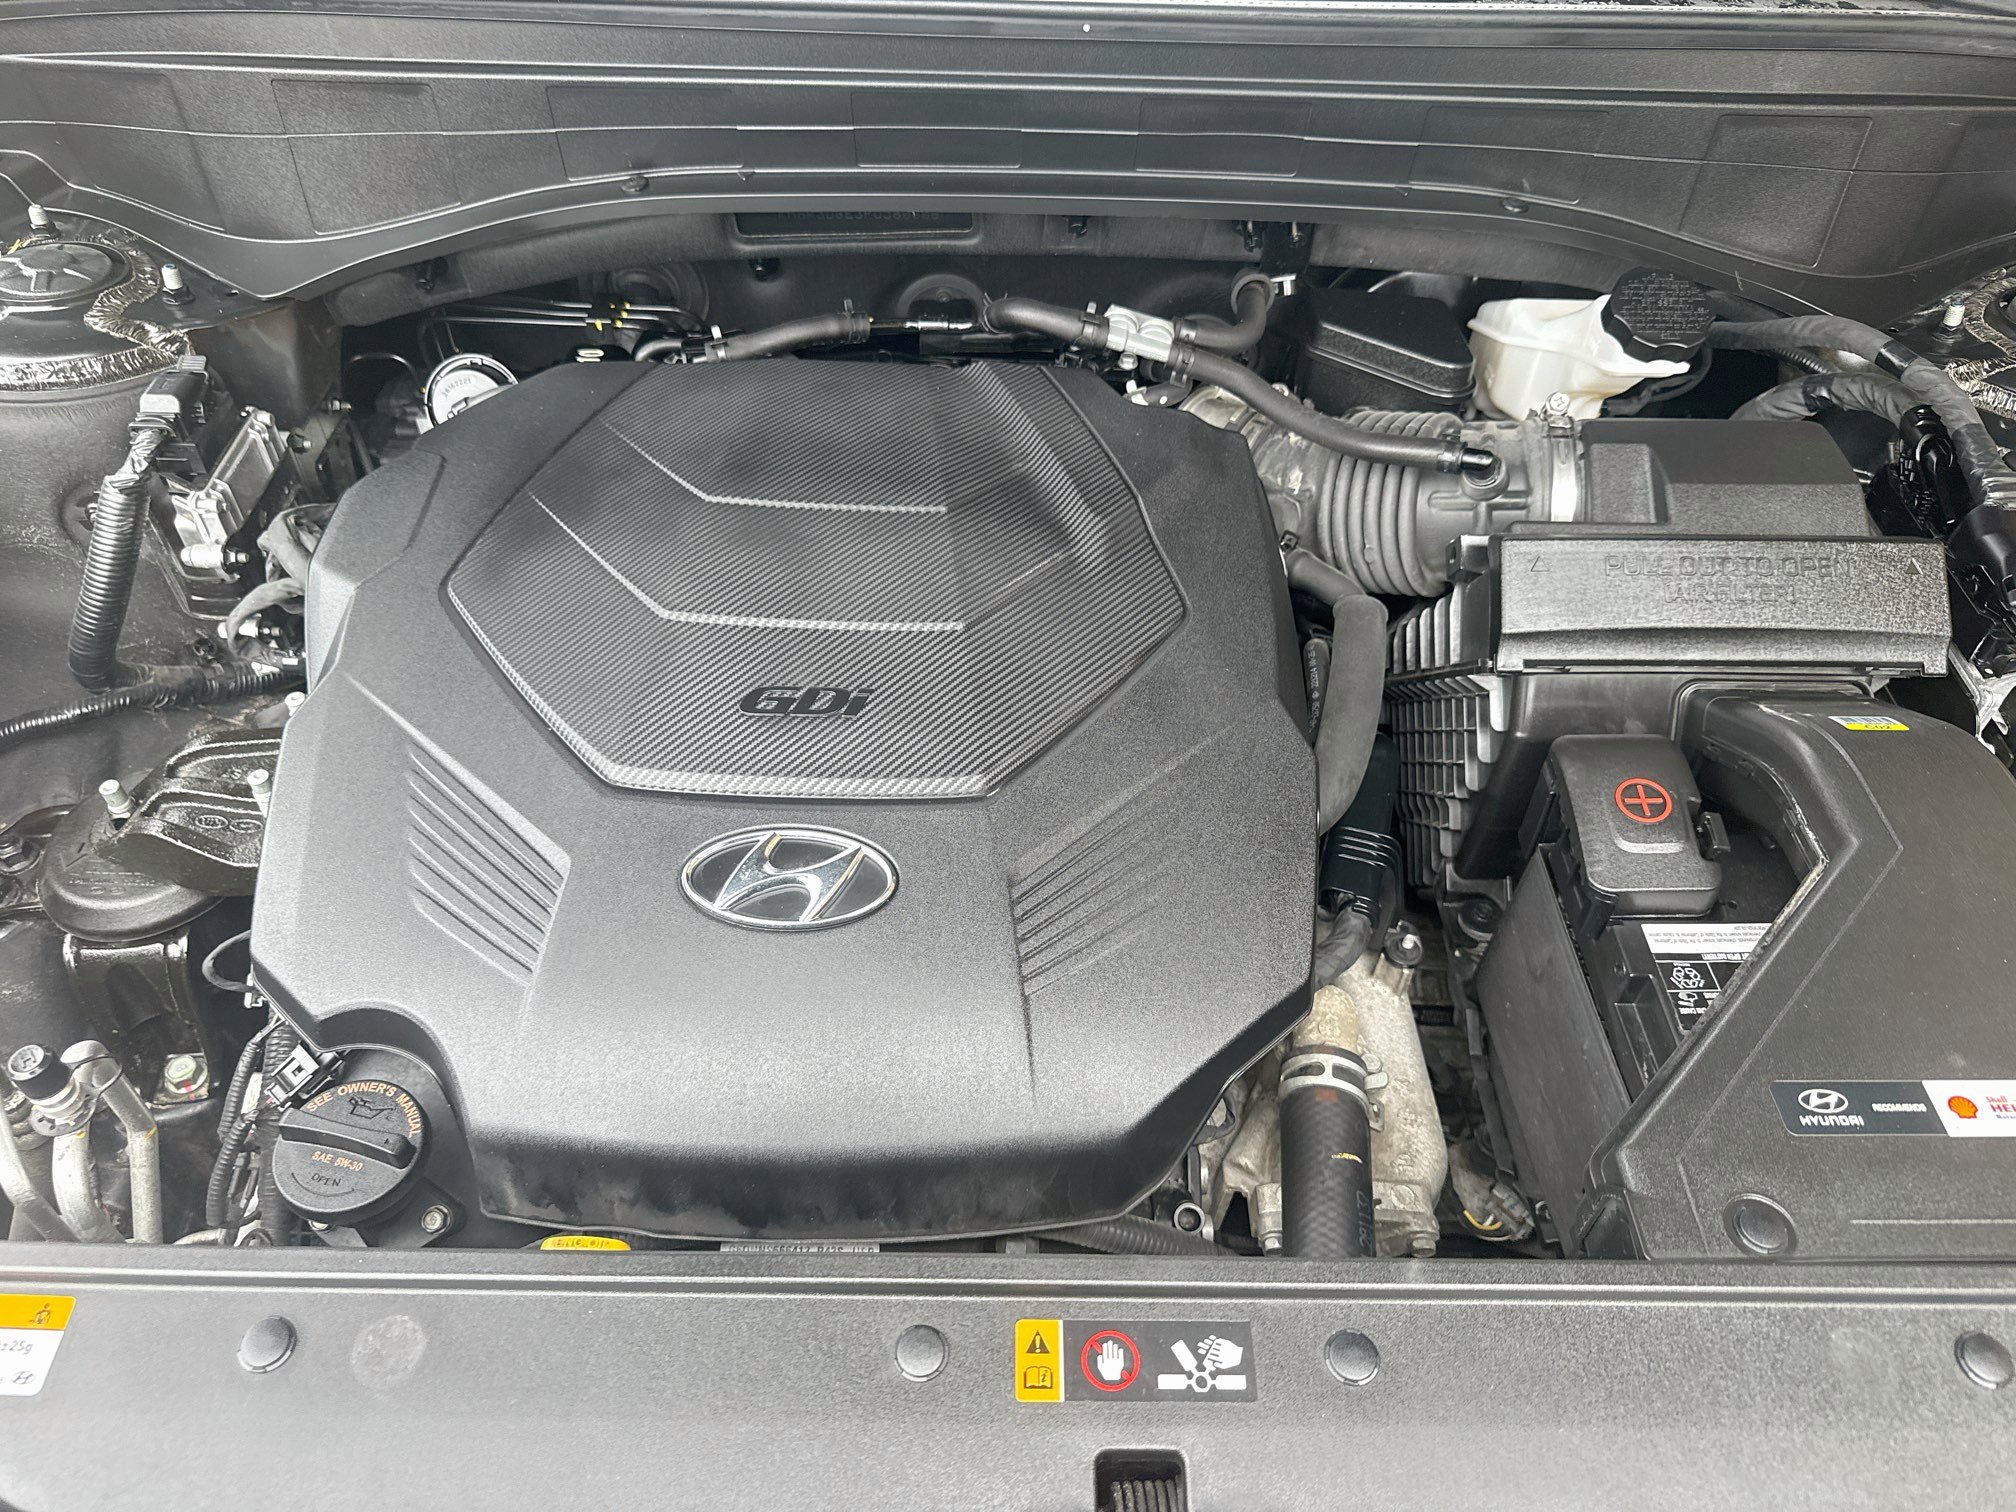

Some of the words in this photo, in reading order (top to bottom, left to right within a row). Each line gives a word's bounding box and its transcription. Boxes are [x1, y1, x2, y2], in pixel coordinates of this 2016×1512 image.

[1604, 555, 1674, 576] PULL
[1679, 556, 1732, 576] OUT
[1735, 557, 1773, 576] TO
[1782, 557, 1851, 577] OPEN
[739, 686, 875, 718] GDi
[306, 1092, 334, 1112] SEE
[337, 1082, 397, 1096] OWNER'S
[396, 1093, 422, 1138] MANUAL
[1872, 1103, 1927, 1112] RECOMMENDS
[1799, 1115, 1864, 1126] HYUNDAI
[312, 1151, 334, 1163] SAE
[335, 1157, 363, 1172] 5W-30
[311, 1173, 342, 1187] OPEN
